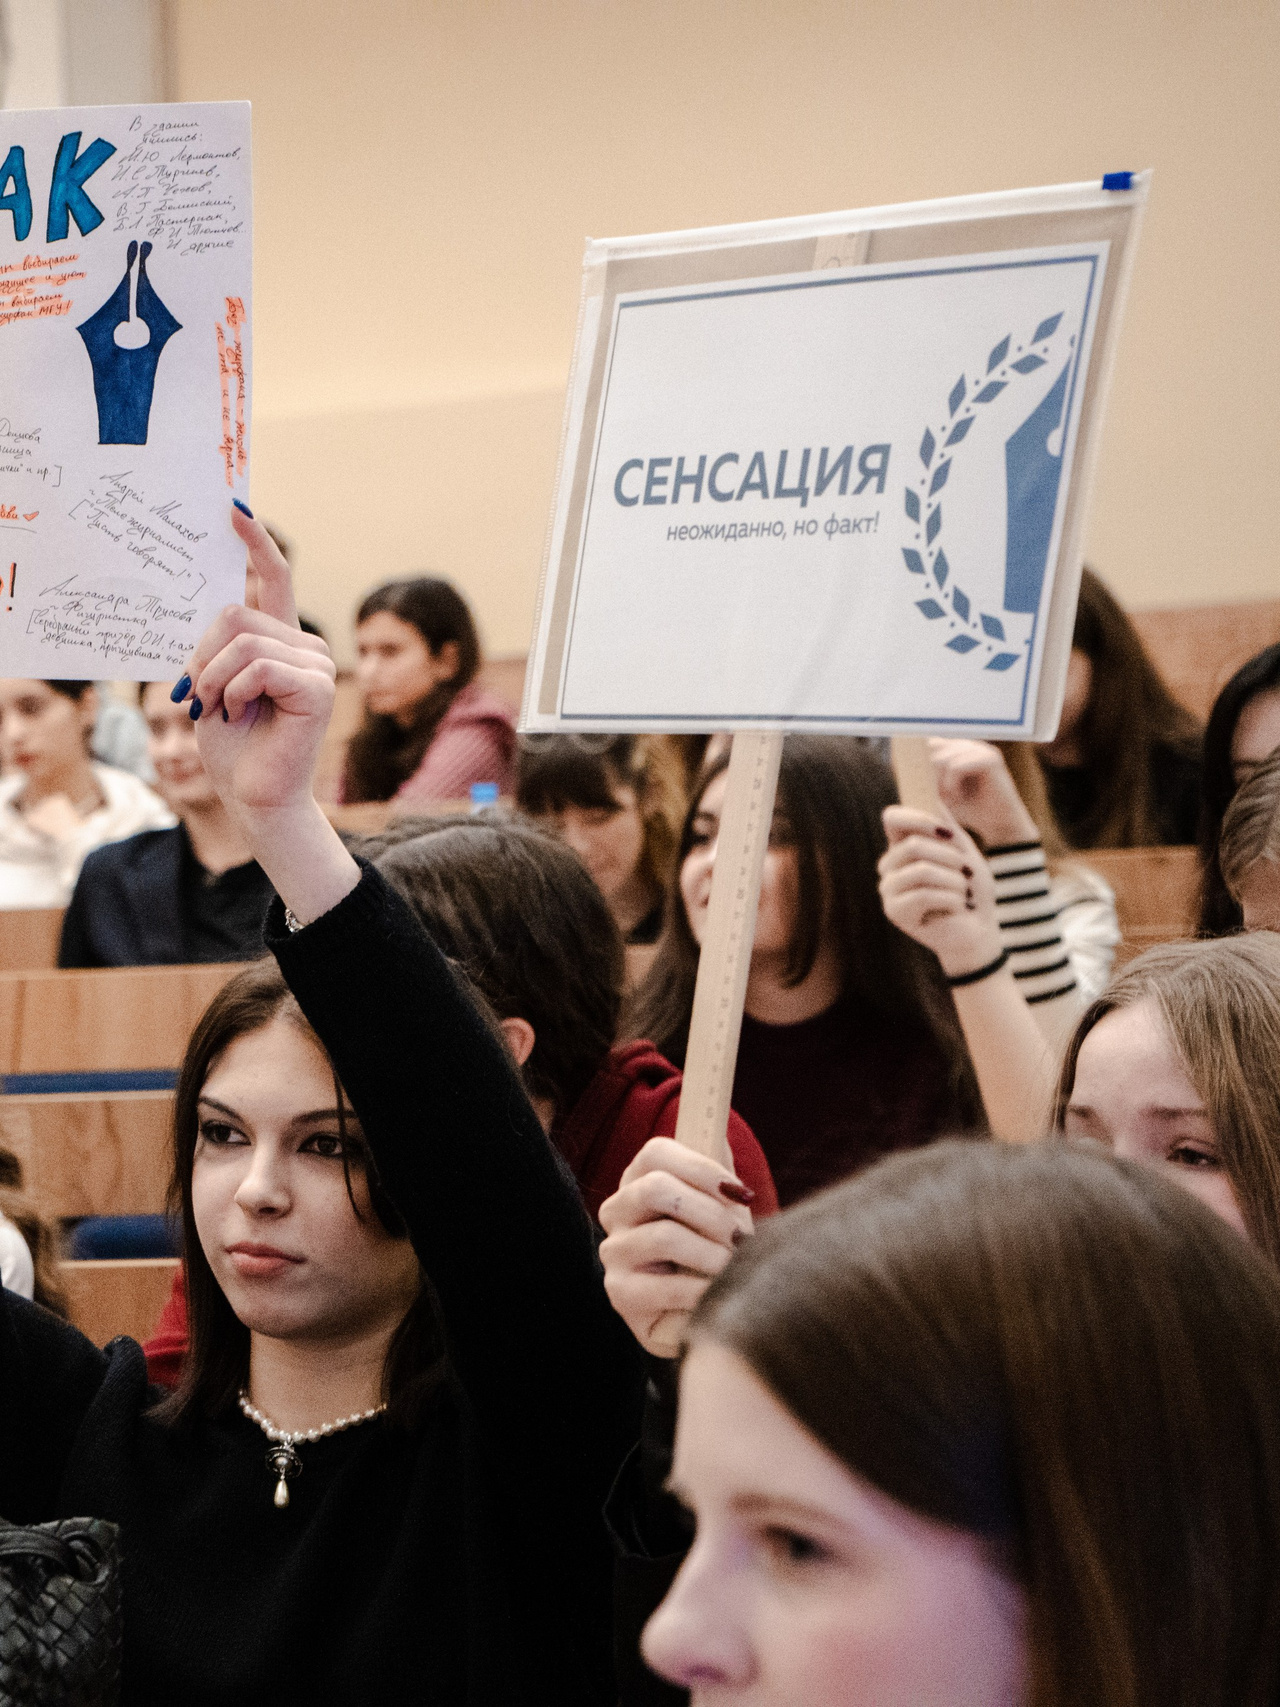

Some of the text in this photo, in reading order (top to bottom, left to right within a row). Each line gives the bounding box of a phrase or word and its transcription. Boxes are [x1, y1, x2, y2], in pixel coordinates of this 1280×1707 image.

[613, 443, 892, 508] СЕНСАЦИЯ
[667, 511, 880, 542] неожиданно, но факт!
